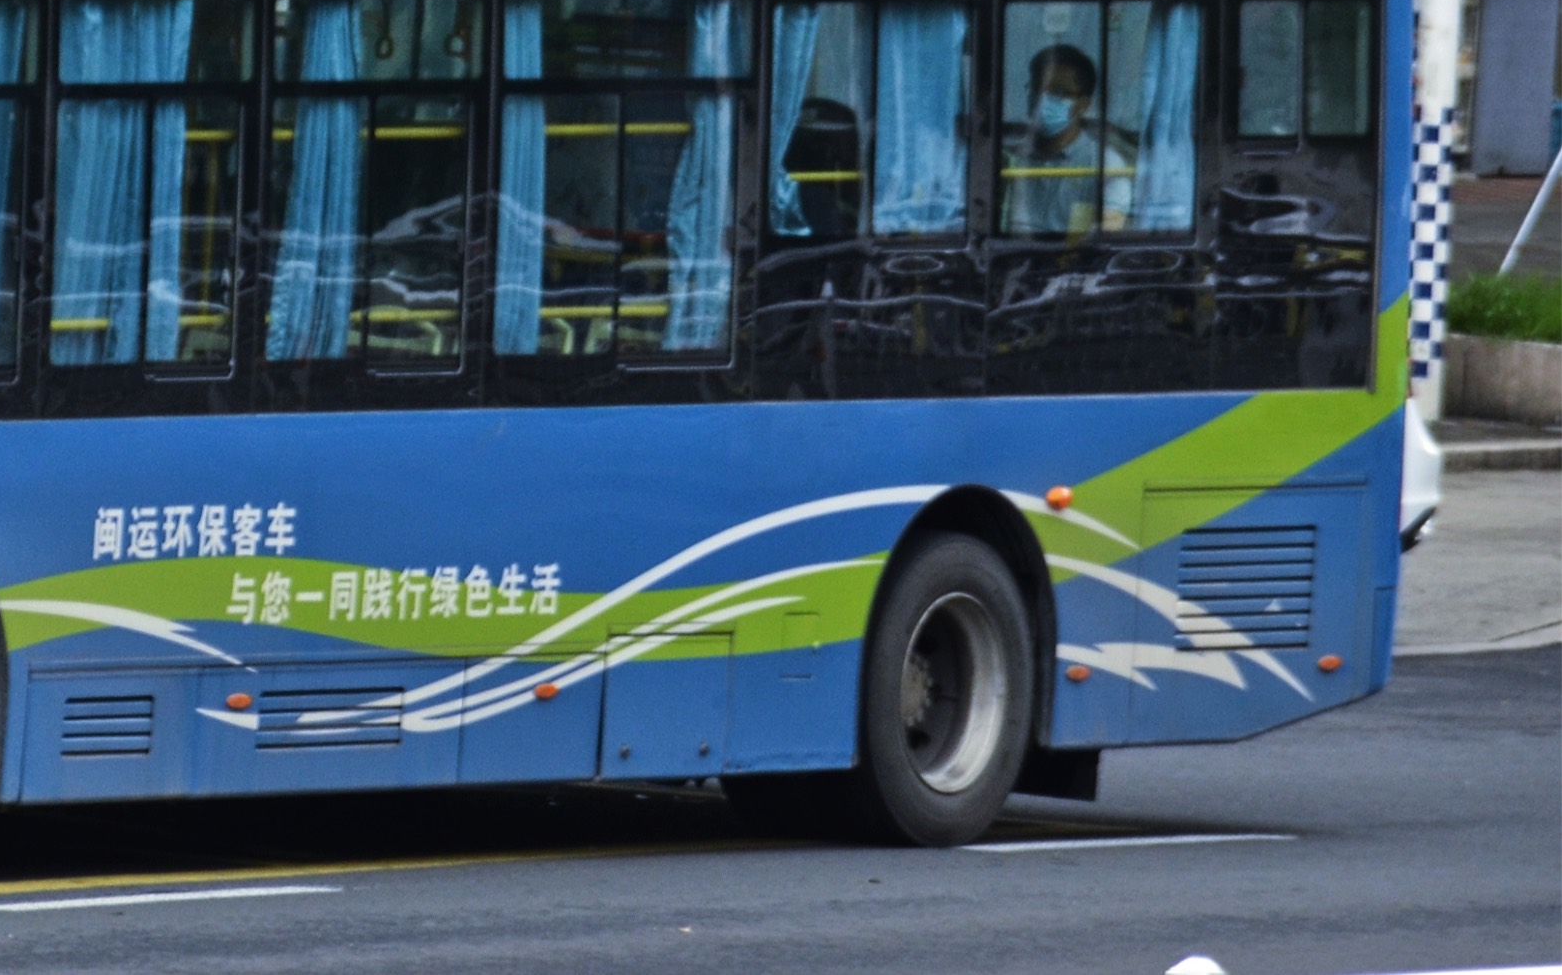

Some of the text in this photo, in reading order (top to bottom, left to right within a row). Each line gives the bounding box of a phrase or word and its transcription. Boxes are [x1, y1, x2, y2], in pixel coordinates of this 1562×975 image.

[92, 501, 297, 561] 闽运环保客车
[225, 563, 562, 625] 与您一同践行绿色生活
